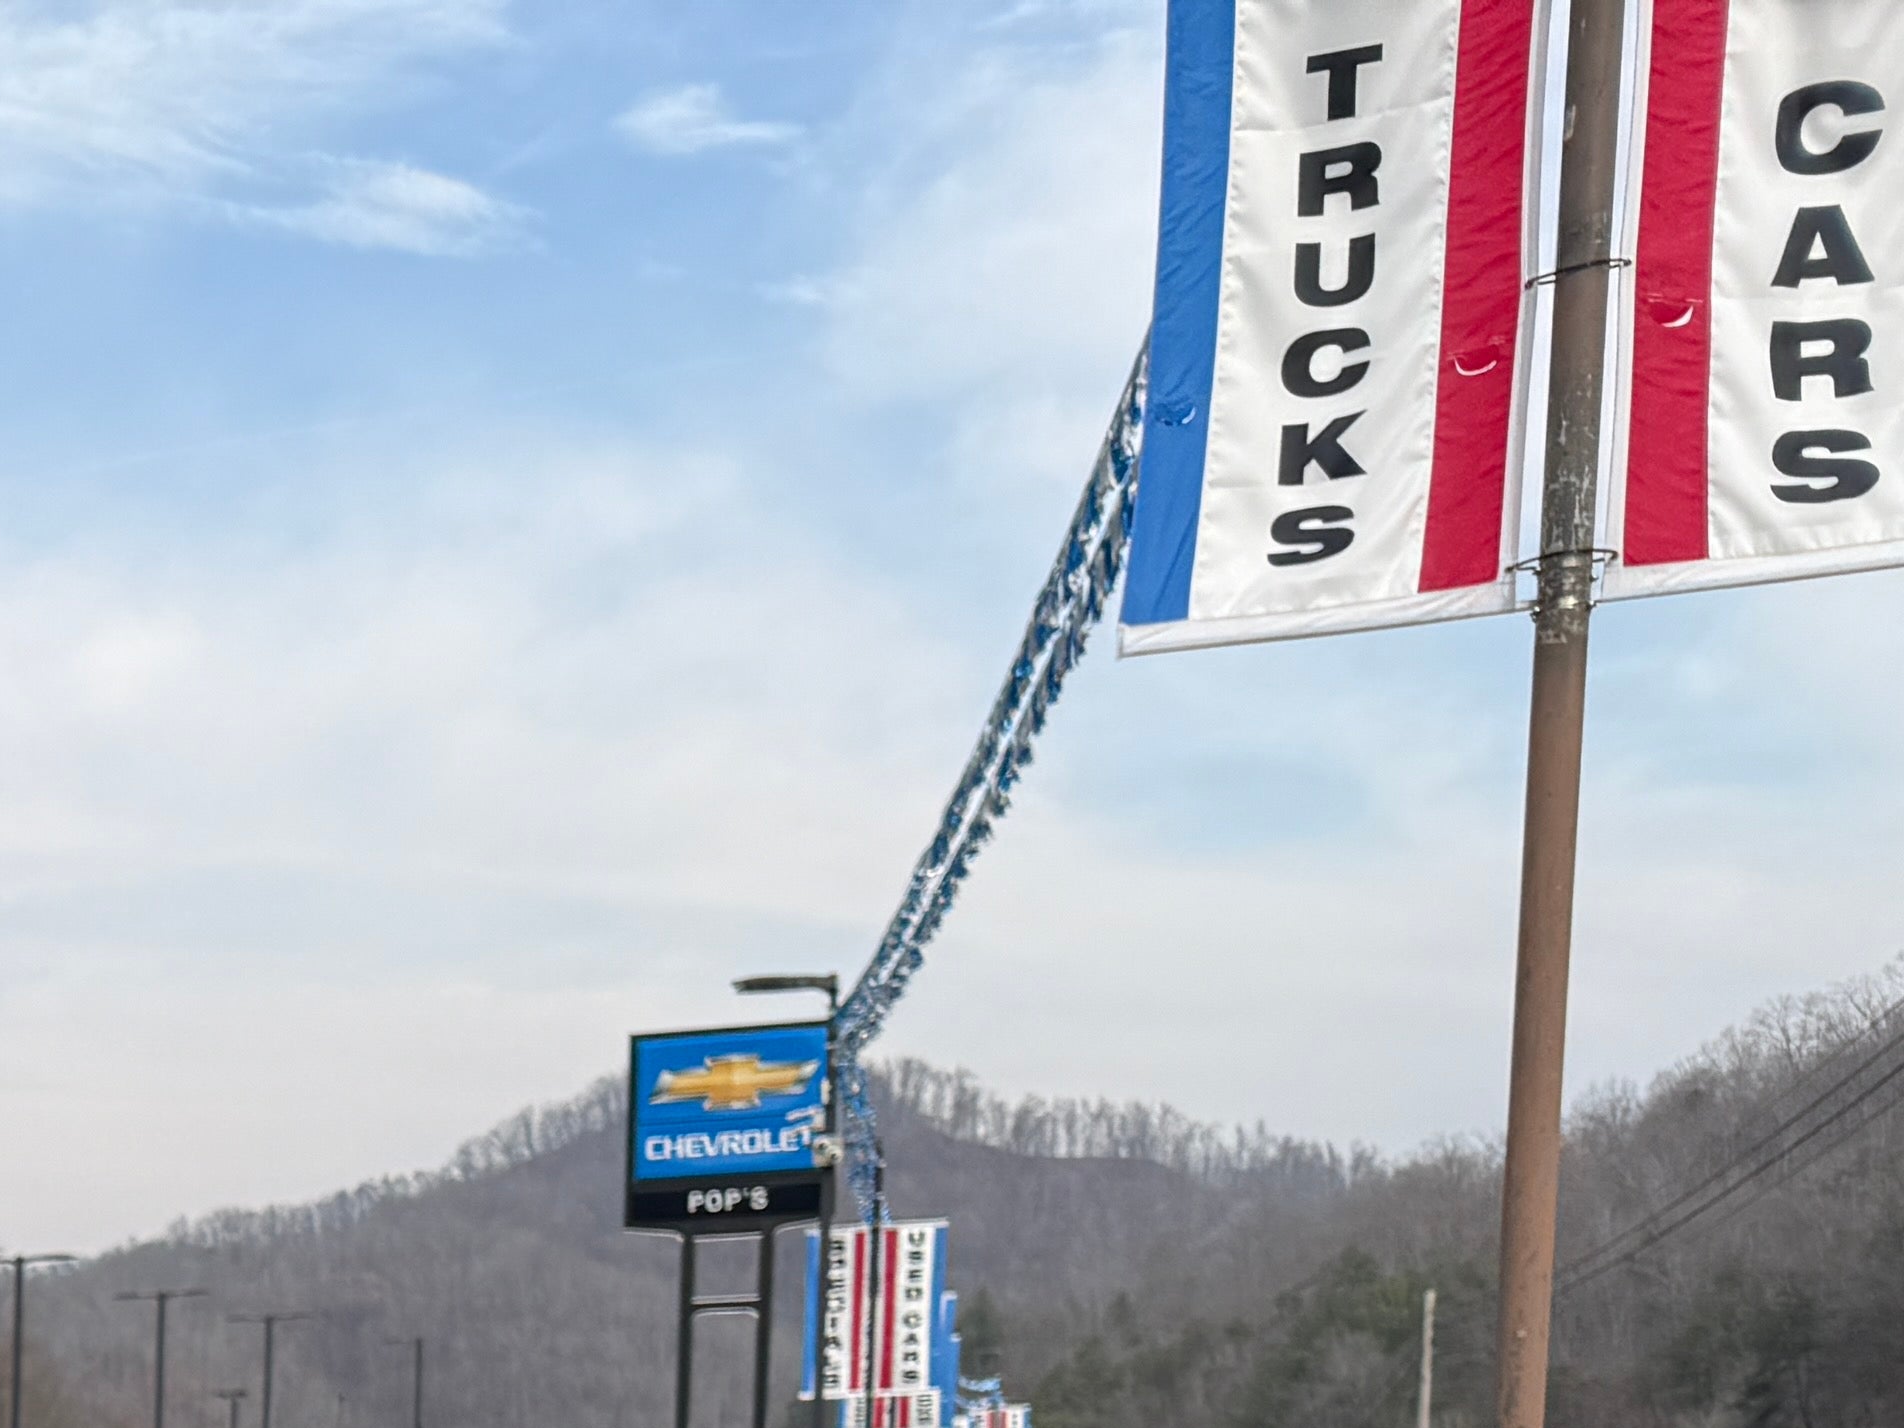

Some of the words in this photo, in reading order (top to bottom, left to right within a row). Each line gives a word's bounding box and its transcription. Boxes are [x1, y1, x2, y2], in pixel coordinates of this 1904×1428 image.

[1266, 42, 1384, 568] TRUCKS
[1769, 79, 1887, 505] CARS
[645, 1124, 812, 1162] CHEVROLET
[687, 1186, 769, 1214] POP'S
[902, 1310, 923, 1384] CARS
